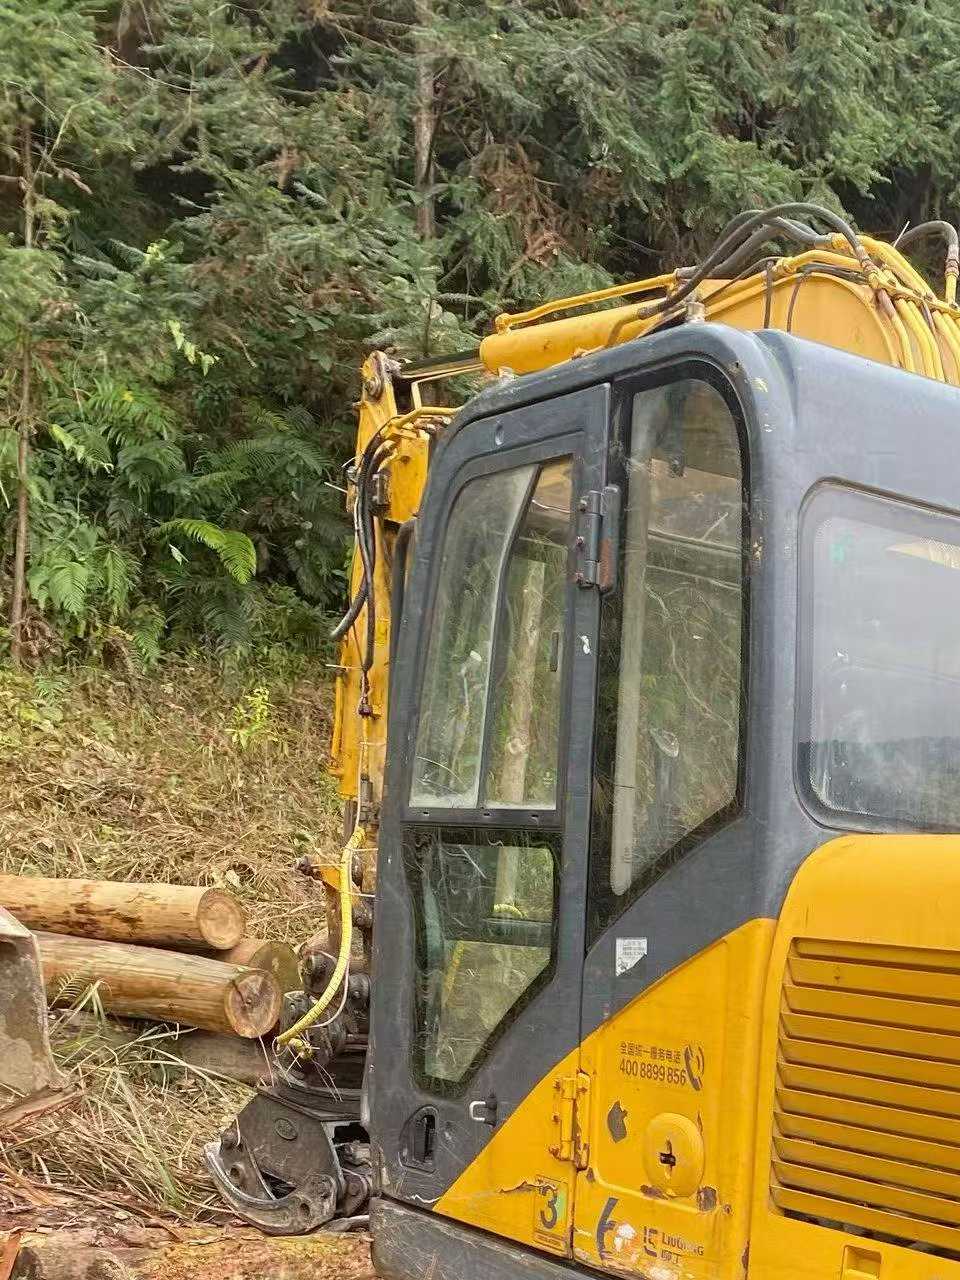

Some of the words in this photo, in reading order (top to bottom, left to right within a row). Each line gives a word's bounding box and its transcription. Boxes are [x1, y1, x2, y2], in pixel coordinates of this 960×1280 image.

[620, 1058, 639, 1077] 400
[640, 1063, 666, 1082] 8899
[667, 1067, 687, 1086] 856
